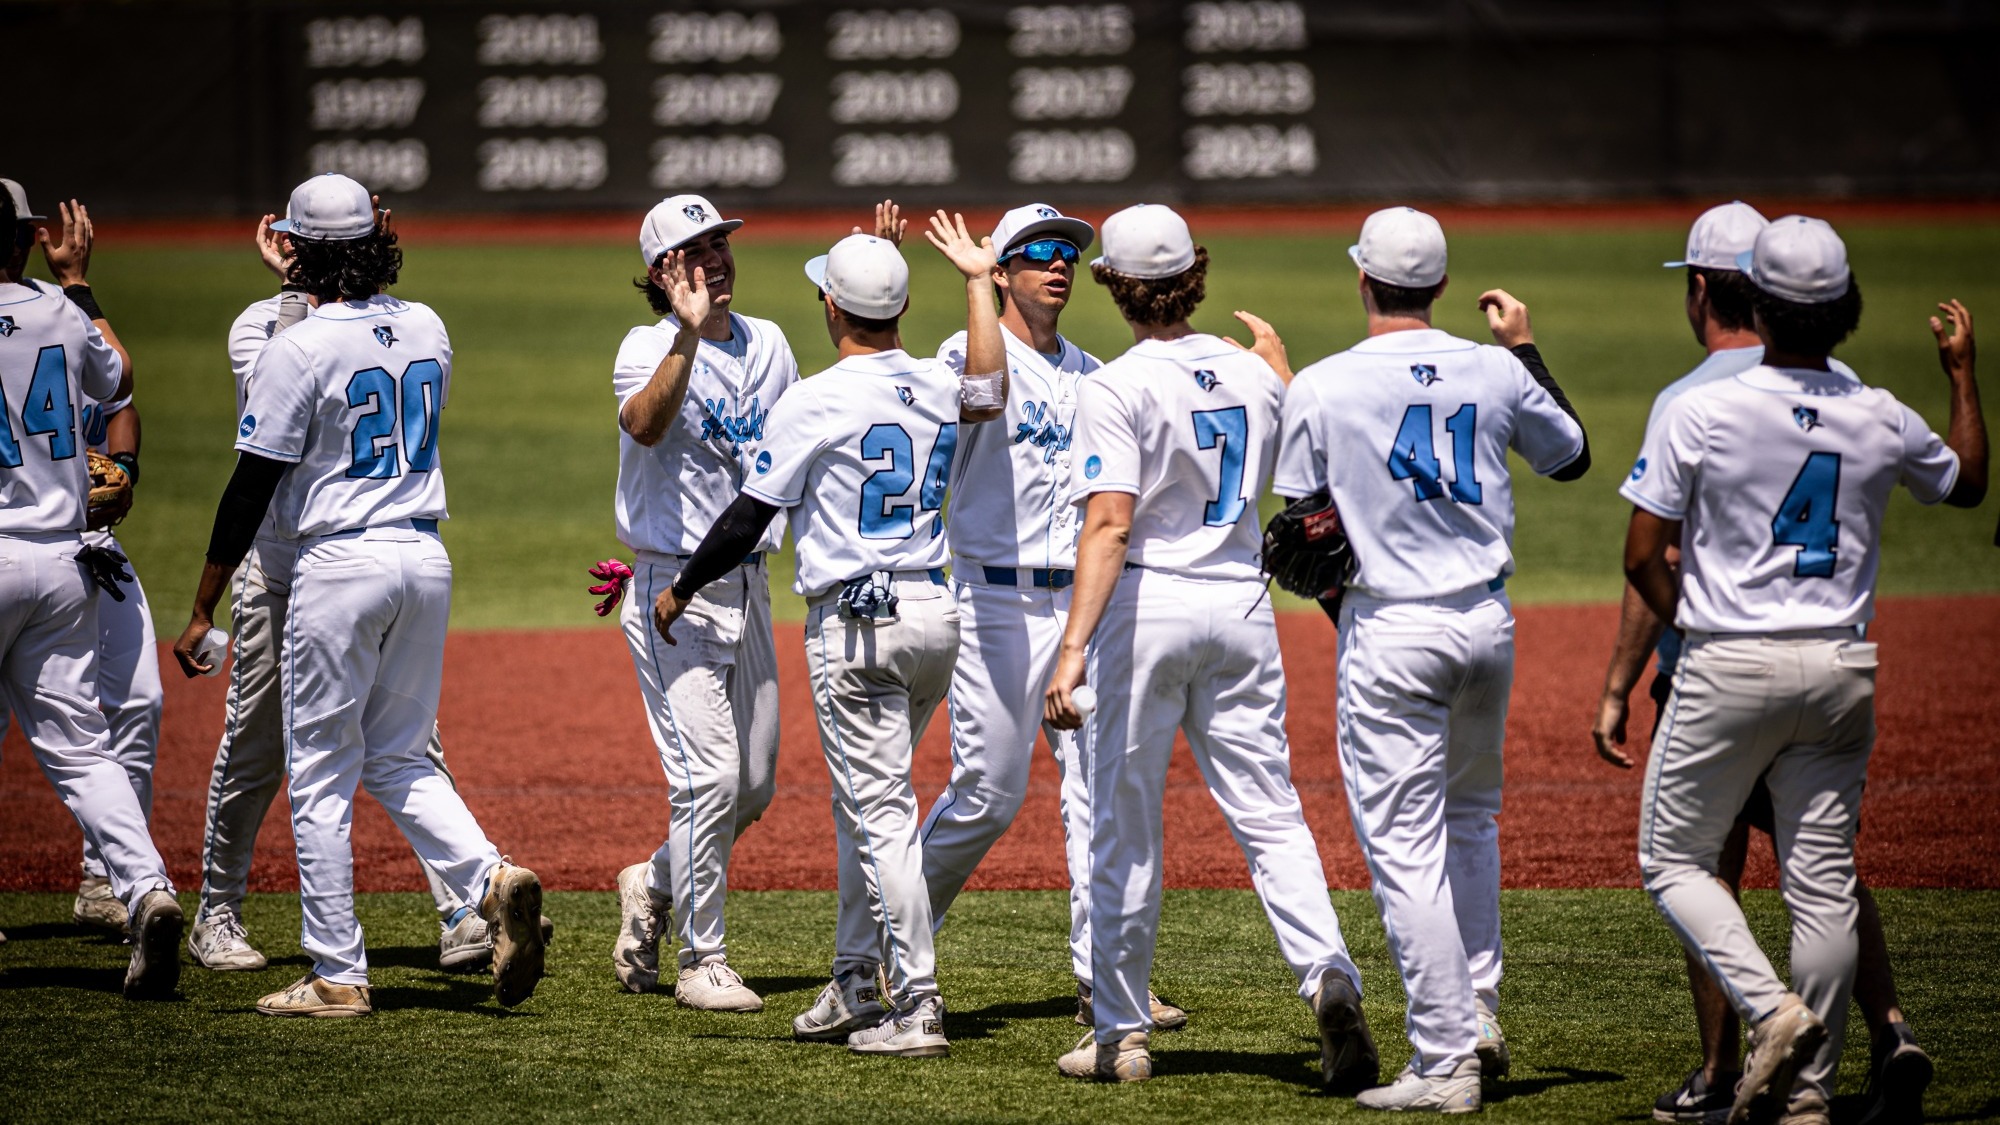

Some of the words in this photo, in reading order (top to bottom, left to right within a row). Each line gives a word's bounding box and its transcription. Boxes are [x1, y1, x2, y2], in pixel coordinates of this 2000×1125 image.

[483, 16, 601, 64] 2001
[651, 13, 781, 63] 2004
[1191, 0, 1306, 51] 2021
[311, 78, 424, 129] 1997
[481, 76, 607, 128] 2002
[654, 72, 782, 127] 2007
[831, 69, 961, 125] 2010
[1012, 65, 1134, 121] 2017
[1186, 63, 1316, 117] 2023
[832, 132, 957, 188] 2011
[1185, 123, 1319, 181] 2024
[345, 358, 443, 480] 20
[858, 422, 957, 540] 24
[1192, 405, 1249, 527] 7
[1387, 403, 1483, 505] 41
[1771, 451, 1841, 578] 4
